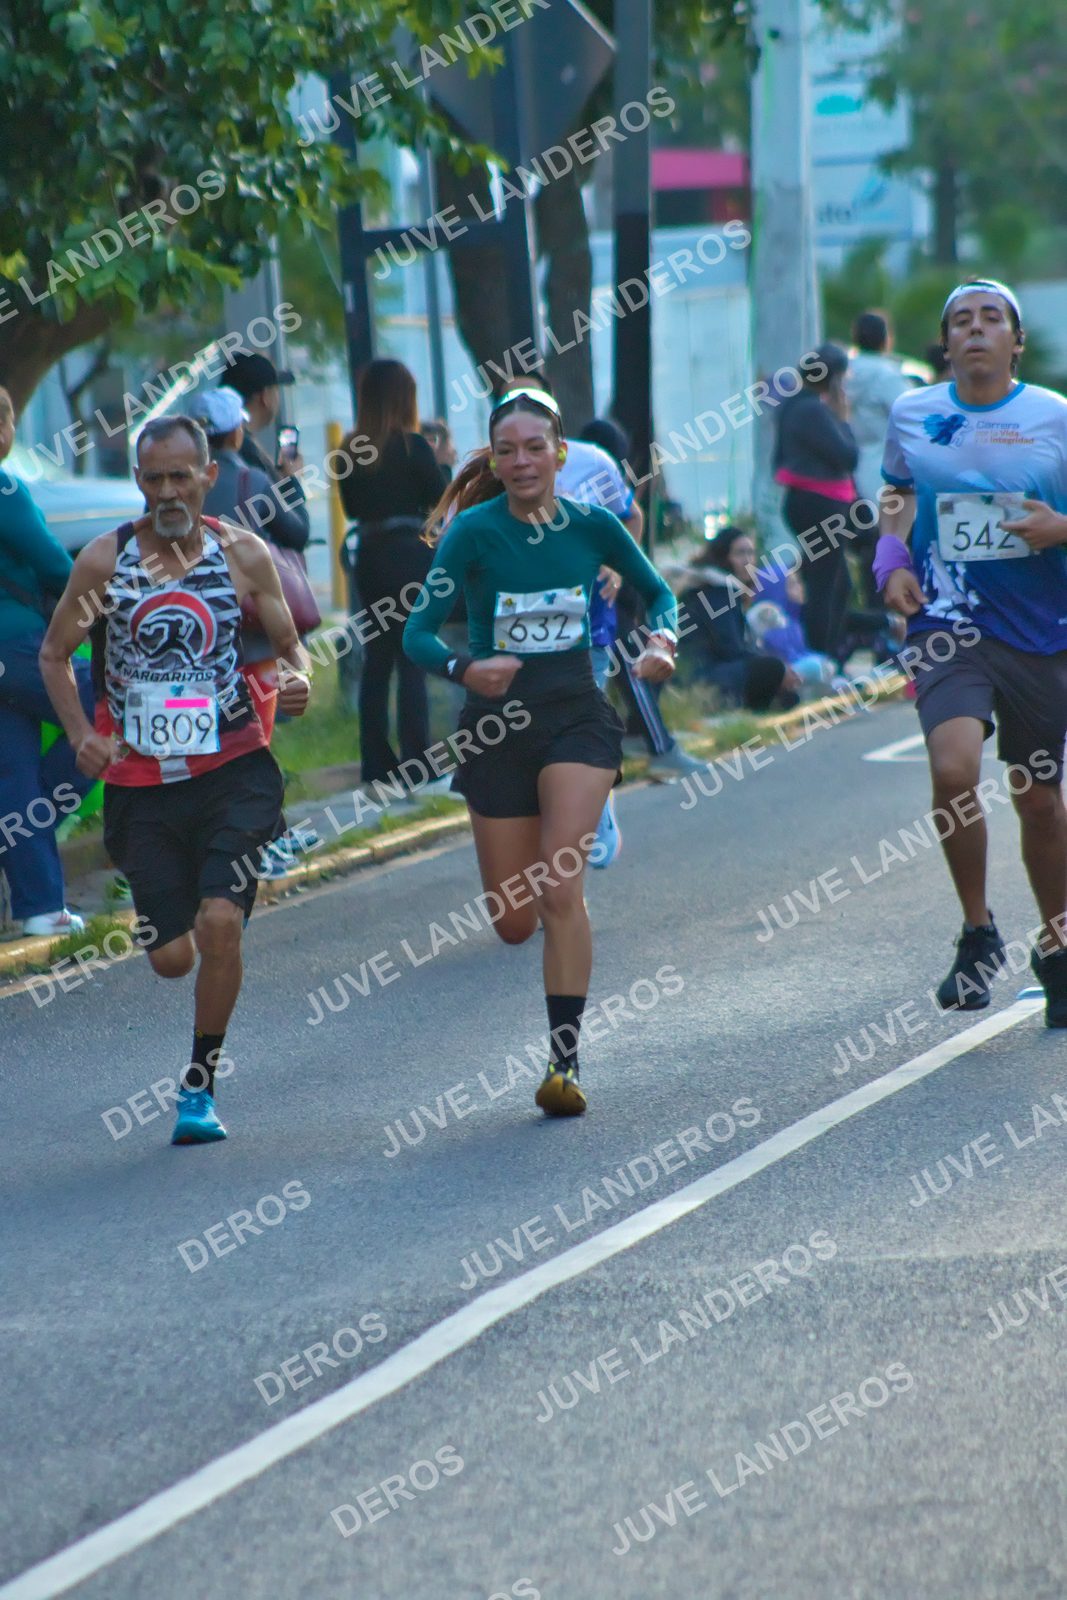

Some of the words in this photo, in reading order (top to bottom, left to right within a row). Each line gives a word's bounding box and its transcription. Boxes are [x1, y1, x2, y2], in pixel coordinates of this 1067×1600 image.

[975, 420, 1019, 429] Carrera
[509, 613, 571, 642] 632
[132, 712, 214, 745] 1809
